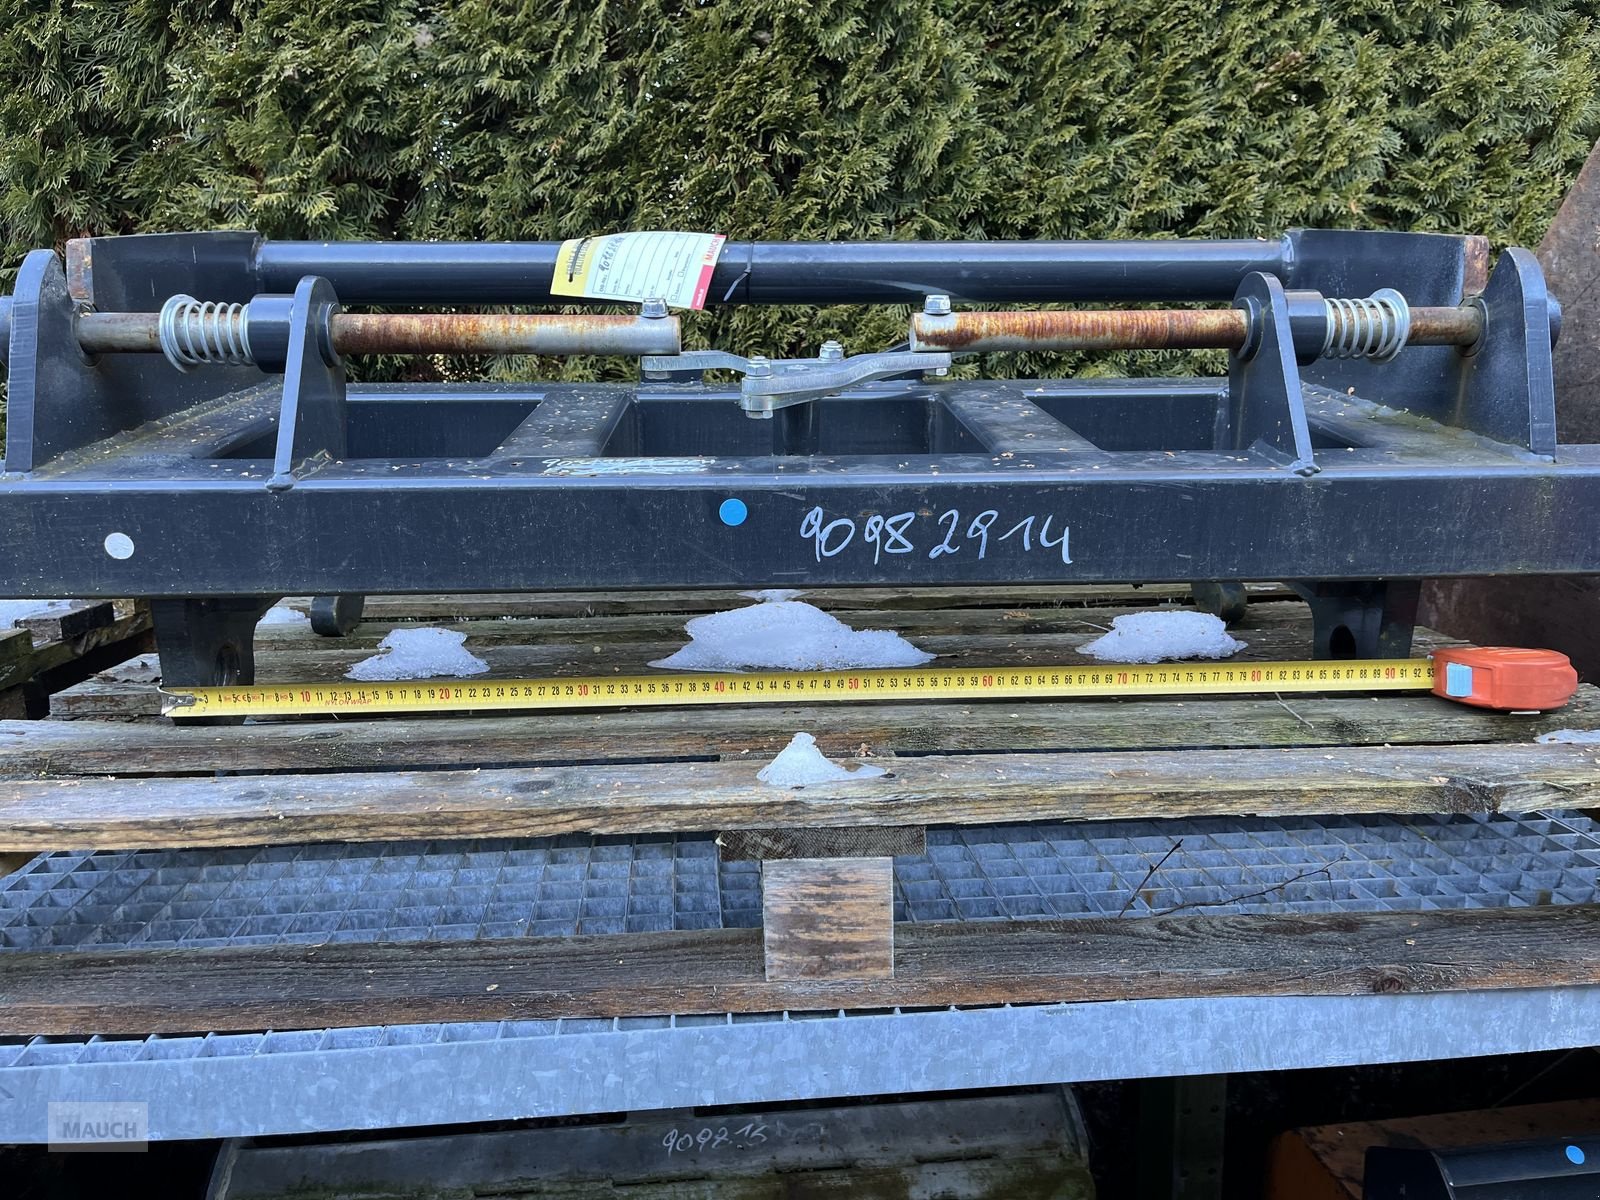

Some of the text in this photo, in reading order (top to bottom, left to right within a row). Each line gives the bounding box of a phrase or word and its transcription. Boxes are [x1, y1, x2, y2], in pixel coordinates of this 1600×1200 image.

[704, 238, 720, 260] MAUCH
[300, 691, 311, 703] 10
[316, 692, 323, 701] 11
[330, 692, 338, 701] 12
[344, 691, 352, 700] 13
[358, 691, 366, 700] 14
[372, 691, 380, 700] 15
[385, 690, 394, 699] 16
[400, 689, 407, 699] 17
[414, 688, 421, 699] 18
[427, 688, 435, 698] 19
[439, 686, 450, 699] 20
[455, 688, 462, 698] 21
[469, 688, 477, 697] 22
[482, 688, 490, 697] 23
[496, 687, 504, 697] 24
[510, 687, 518, 696] 25
[524, 687, 532, 696] 26
[538, 687, 546, 696] 27
[552, 686, 560, 696] 28
[566, 686, 574, 695] 29
[578, 684, 588, 696] 30
[593, 685, 600, 694] 31
[606, 685, 615, 694] 32
[620, 684, 628, 694] 33
[634, 684, 642, 693] 34
[648, 684, 656, 693] 35
[661, 683, 669, 692] 36
[675, 683, 683, 692] 37
[689, 682, 697, 692] 38
[702, 682, 710, 691] 39
[714, 681, 725, 692] 40
[729, 681, 736, 690] 41
[742, 681, 751, 690] 42
[756, 681, 764, 690] 43
[770, 681, 777, 690] 44
[783, 680, 791, 690] 45
[796, 680, 804, 689] 46
[810, 680, 818, 689] 47
[823, 680, 831, 689] 48
[836, 679, 844, 688] 49
[848, 678, 859, 689] 50
[863, 679, 871, 688] 51
[876, 678, 884, 688] 52
[890, 678, 898, 687] 53
[903, 678, 911, 687] 54
[917, 678, 925, 687] 55
[930, 677, 938, 686] 56
[944, 677, 951, 686] 57
[957, 677, 965, 686] 58
[971, 677, 978, 686] 59
[982, 675, 993, 687] 60
[997, 676, 1005, 685] 61
[1011, 676, 1019, 685] 62
[1024, 676, 1032, 685] 63
[1037, 676, 1046, 685] 64
[1051, 675, 1059, 684] 65
[1064, 675, 1073, 684] 66
[1078, 675, 1086, 684] 67
[1091, 674, 1100, 684] 68
[1105, 674, 1113, 683] 69
[1117, 673, 1128, 684] 70
[1132, 674, 1139, 683] 71
[1145, 673, 1153, 682] 72
[1159, 673, 1167, 682] 73
[1172, 673, 1180, 682] 74
[1186, 672, 1193, 682] 75
[1199, 672, 1207, 681] 76
[1212, 672, 1220, 681] 77
[1226, 672, 1233, 681] 78
[1239, 671, 1247, 680] 79
[1251, 670, 1261, 682] 80
[1266, 671, 1273, 680] 81
[1279, 671, 1287, 680] 82
[1293, 670, 1300, 680] 83
[1306, 670, 1314, 679] 84
[1319, 670, 1327, 679] 85
[1333, 669, 1340, 679] 86
[1346, 669, 1354, 678] 87
[1360, 669, 1367, 678] 88
[1373, 668, 1381, 678] 89
[1385, 667, 1395, 679] 90
[1400, 668, 1407, 677] 91
[1414, 668, 1421, 677] 92
